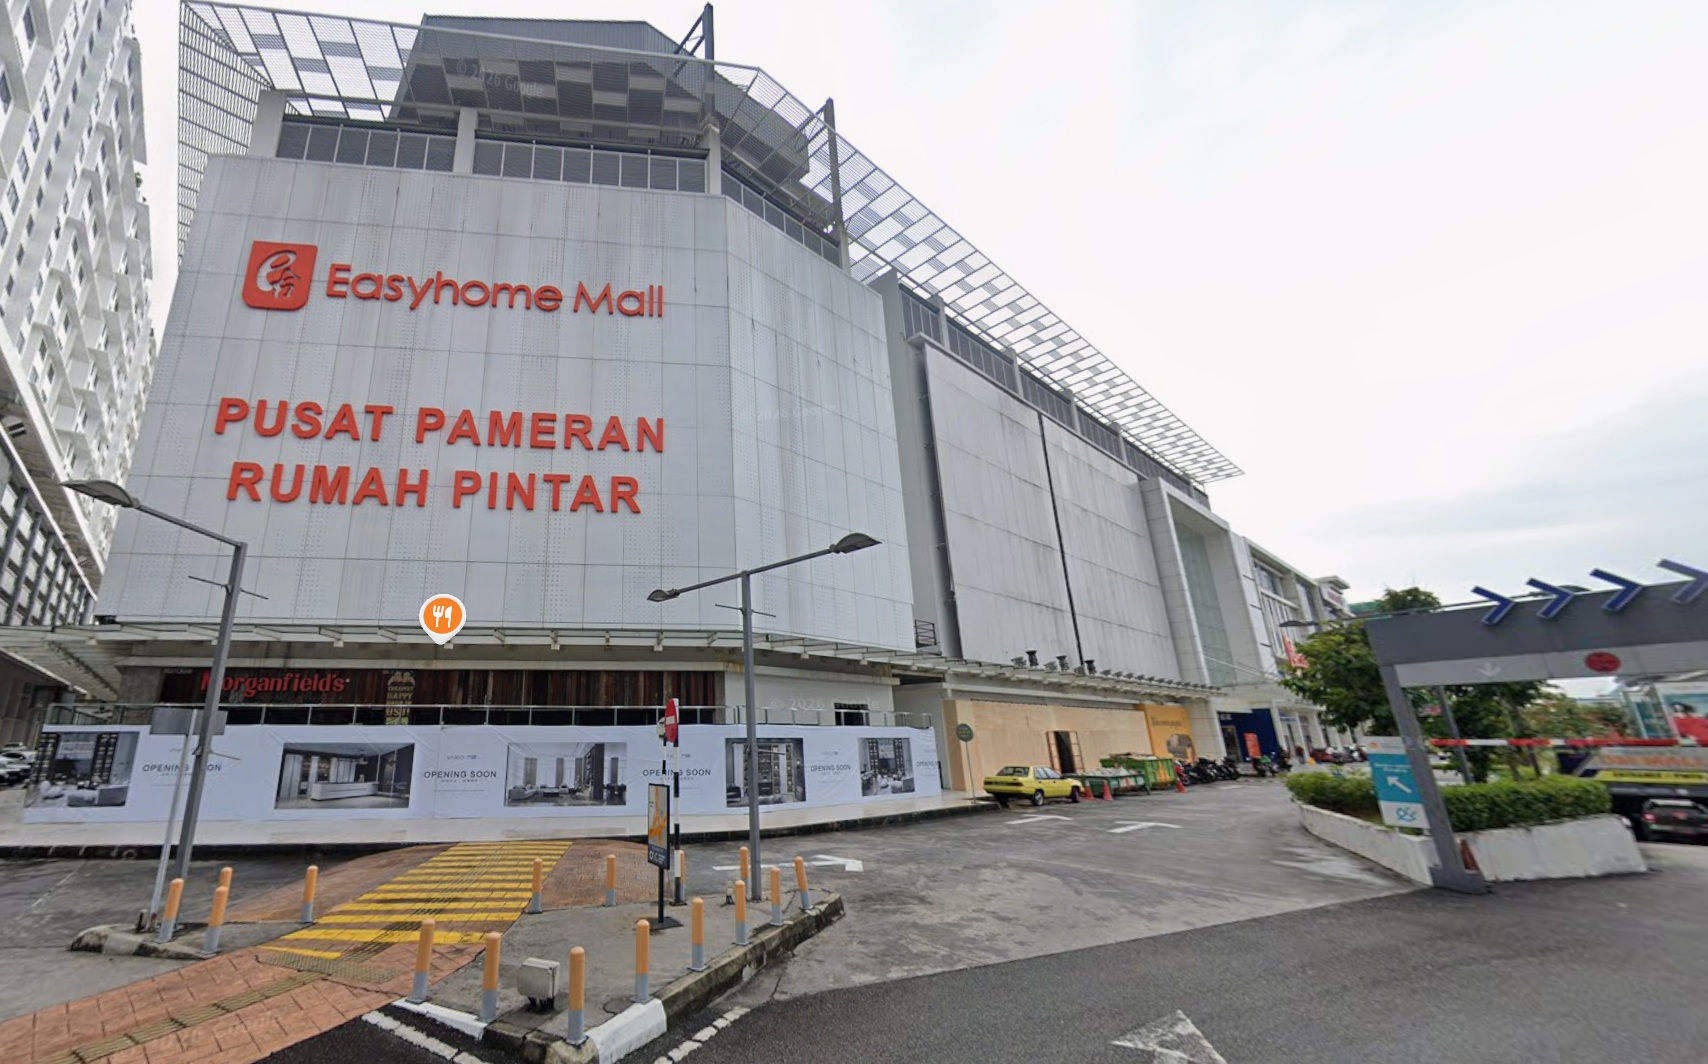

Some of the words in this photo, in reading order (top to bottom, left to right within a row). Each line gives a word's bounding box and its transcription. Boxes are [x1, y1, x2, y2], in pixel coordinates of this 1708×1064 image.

[326, 263, 563, 312] Easyhome
[573, 280, 663, 318] Mall
[214, 396, 393, 441] PUSAT
[416, 406, 665, 453] PAMERAN
[226, 461, 428, 507] RUMAH
[452, 470, 641, 514] PINTAR
[424, 771, 467, 779] OPENING
[470, 770, 497, 778] SOON
[810, 764, 835, 772] OPENING
